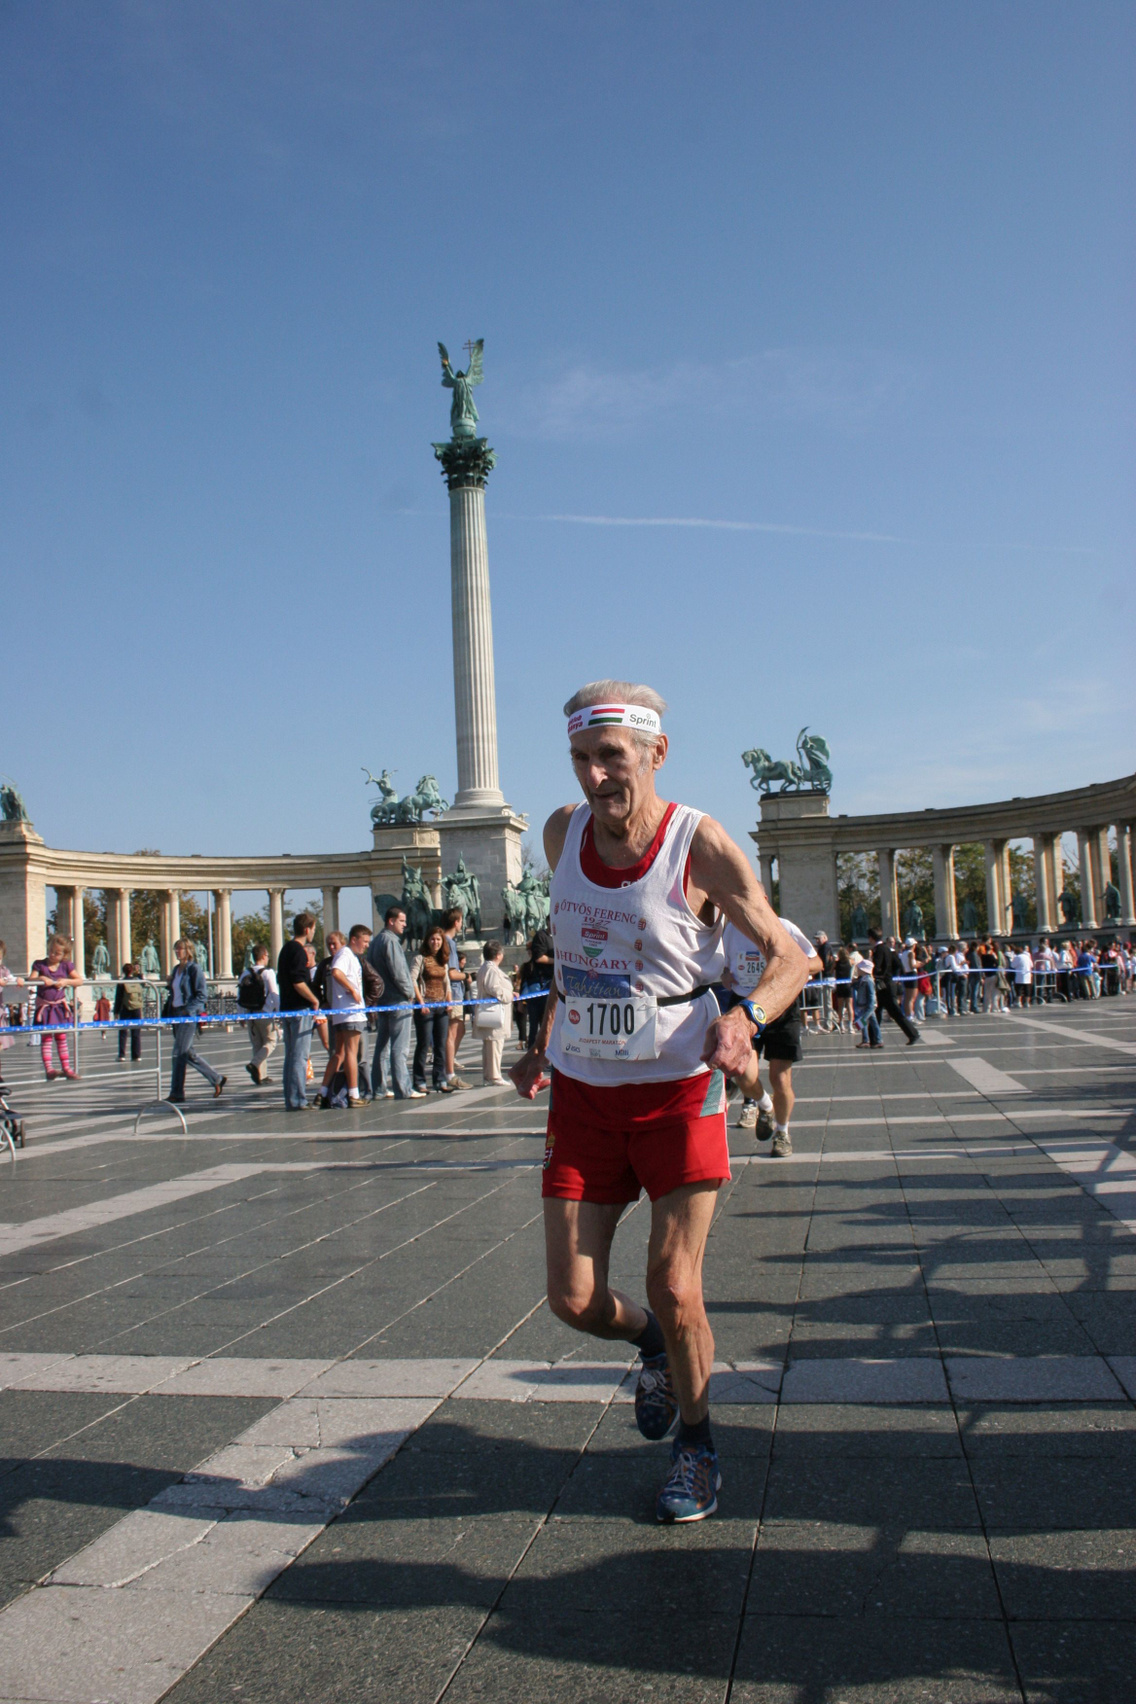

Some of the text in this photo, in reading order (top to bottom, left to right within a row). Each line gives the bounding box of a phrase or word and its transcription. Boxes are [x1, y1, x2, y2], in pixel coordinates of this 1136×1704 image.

[629, 714, 657, 728] Sprint
[593, 907, 637, 924] FERENC
[560, 951, 632, 970] HUNGARY
[567, 975, 621, 996] Tahitian
[587, 1003, 635, 1035] 1700
